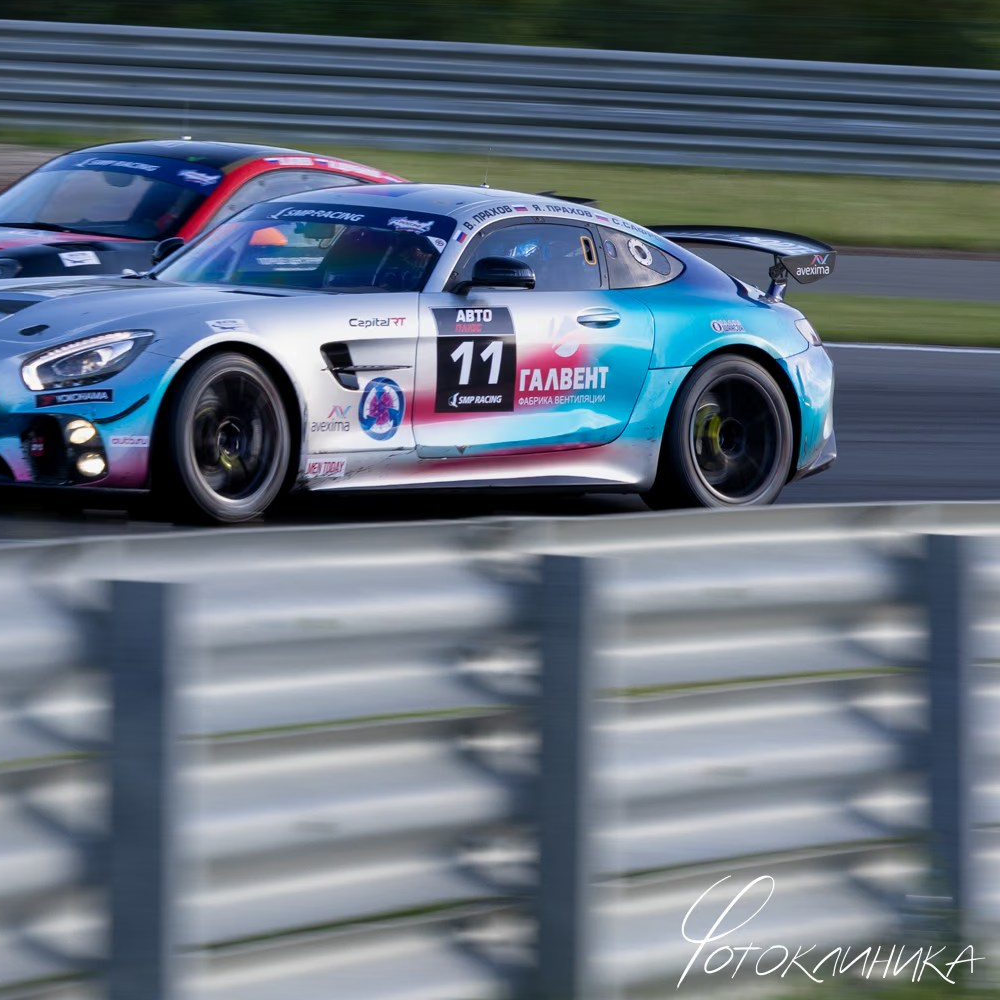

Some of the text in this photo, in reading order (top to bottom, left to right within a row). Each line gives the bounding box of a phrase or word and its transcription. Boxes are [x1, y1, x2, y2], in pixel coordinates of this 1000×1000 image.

[311, 209, 366, 222] RACING
[462, 205, 513, 231] В. ПРАХОВ
[532, 204, 593, 218] Я. ПРАХОВ
[796, 263, 830, 276] avexima
[450, 340, 504, 386] 11
[519, 366, 609, 392] ГАЛВЕНТ
[458, 394, 503, 405] SMP RACING
[518, 394, 606, 406] ФАБРИКА ВЕНТИЛЯЦИИ
[311, 418, 350, 432] avexima
